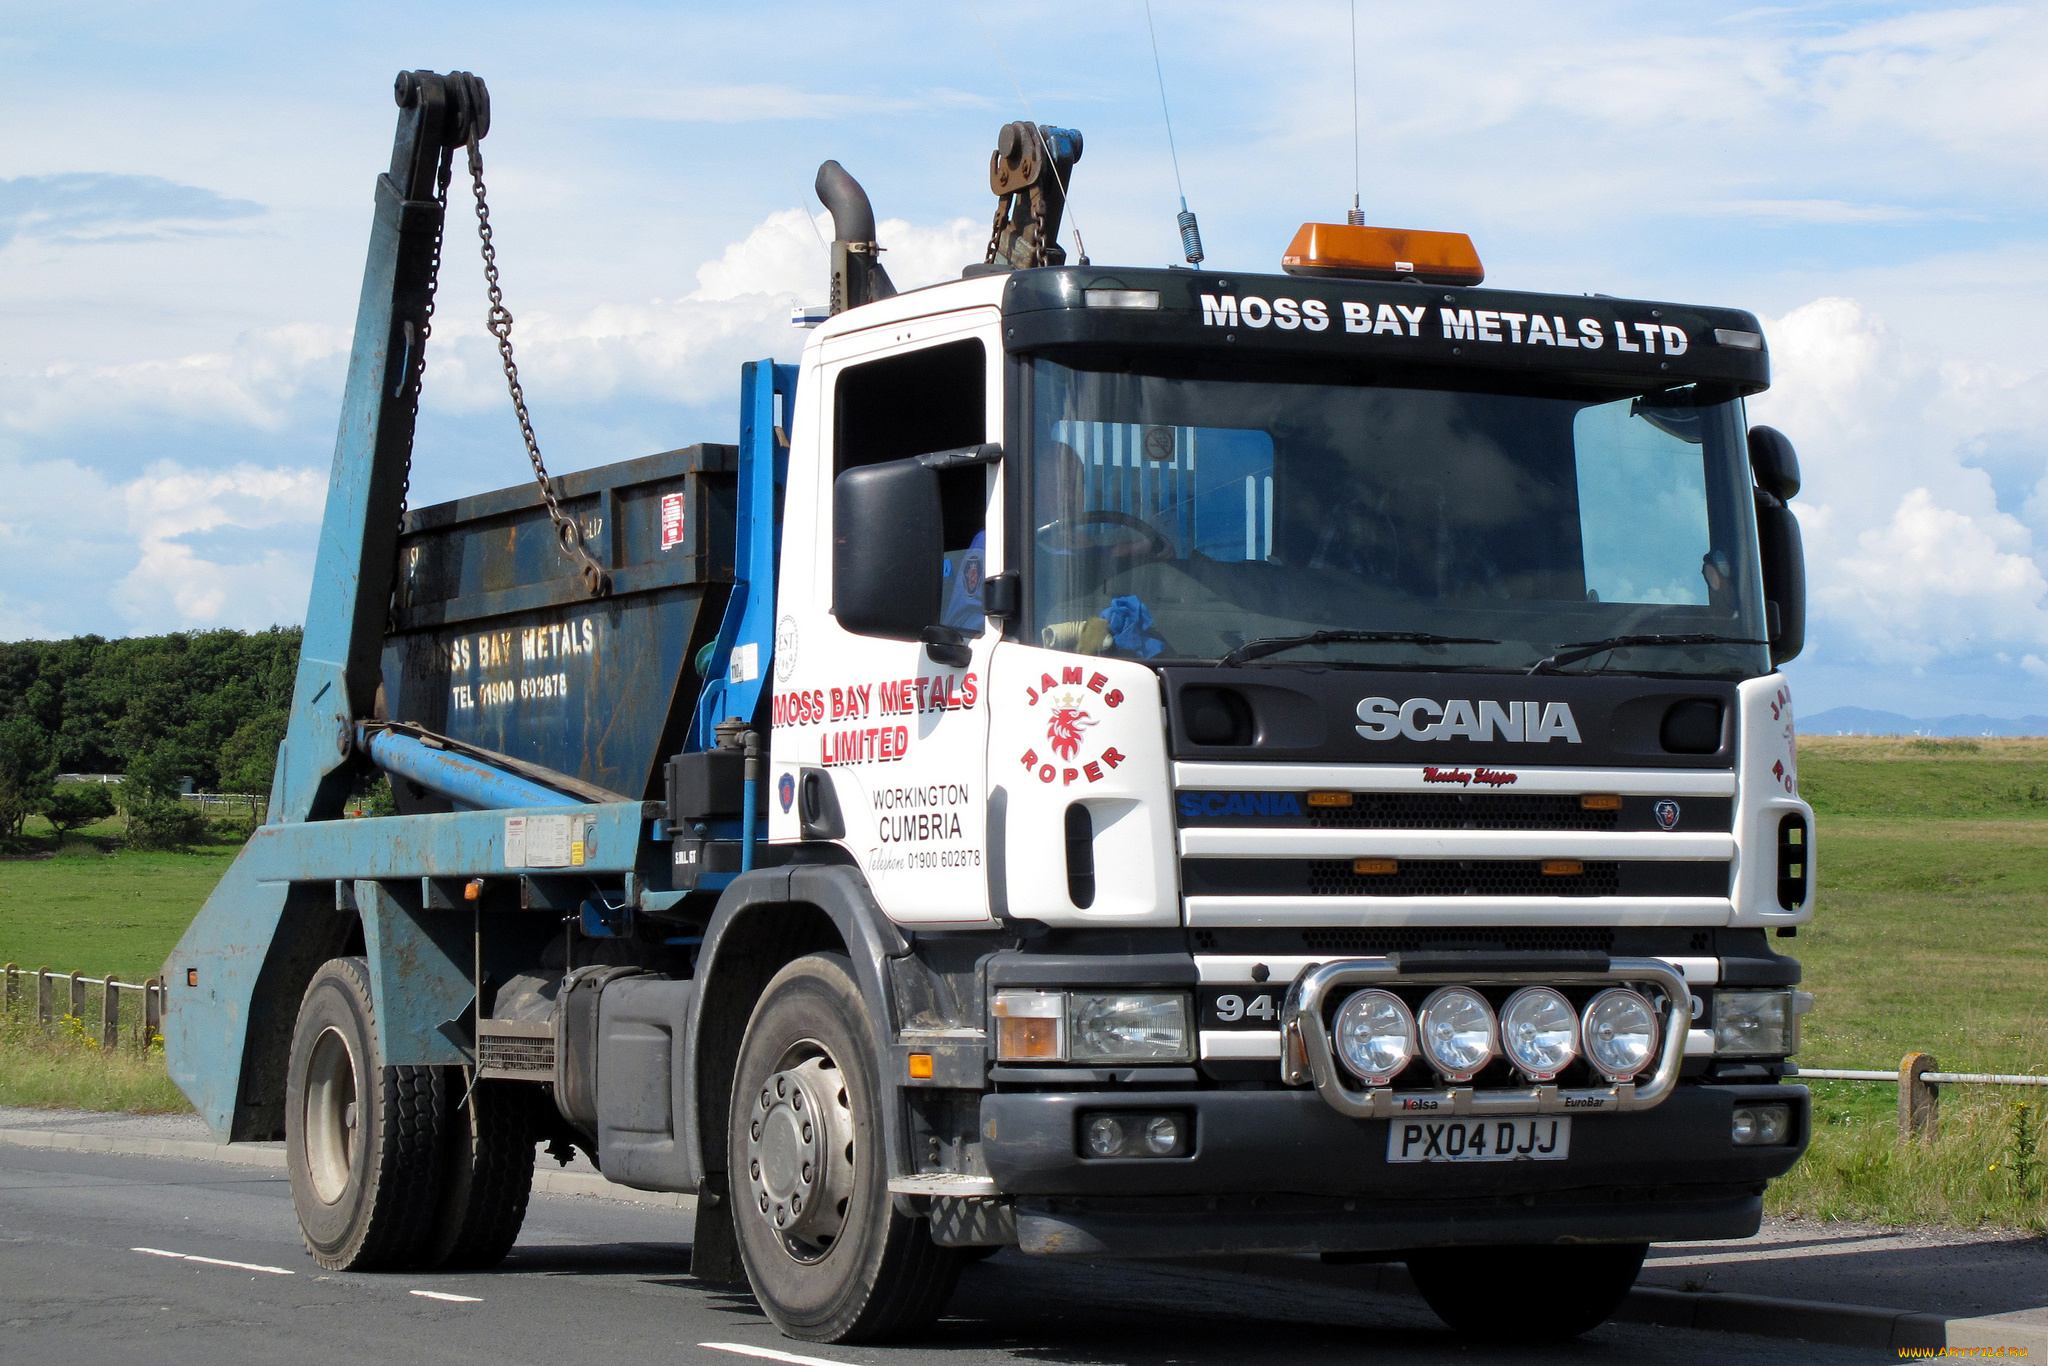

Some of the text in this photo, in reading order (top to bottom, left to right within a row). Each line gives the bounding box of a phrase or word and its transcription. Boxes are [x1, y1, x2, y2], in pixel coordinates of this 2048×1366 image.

[1200, 294, 1688, 356] MOSS BAY METALS LTD
[478, 632, 511, 667] BAY
[521, 618, 593, 660] METALS
[778, 632, 794, 651] EST
[453, 685, 474, 709] TEL
[772, 672, 978, 729] MOSS BAY METALS
[1026, 666, 1125, 708] JAMES
[1355, 697, 1582, 743] SCANIA
[821, 725, 909, 767] LIMITED
[1020, 747, 1126, 787] ROPER
[873, 784, 968, 810] WORKINGTON
[1180, 793, 1302, 816] SCANIA
[880, 812, 962, 843] CUMBRIA
[868, 847, 981, 880] Telephone 01900 602878
[1216, 994, 1280, 1021] 94
[1402, 1097, 1605, 1110] Kelsa EuroBar
[1402, 1121, 1558, 1157] PX04 DJJ
